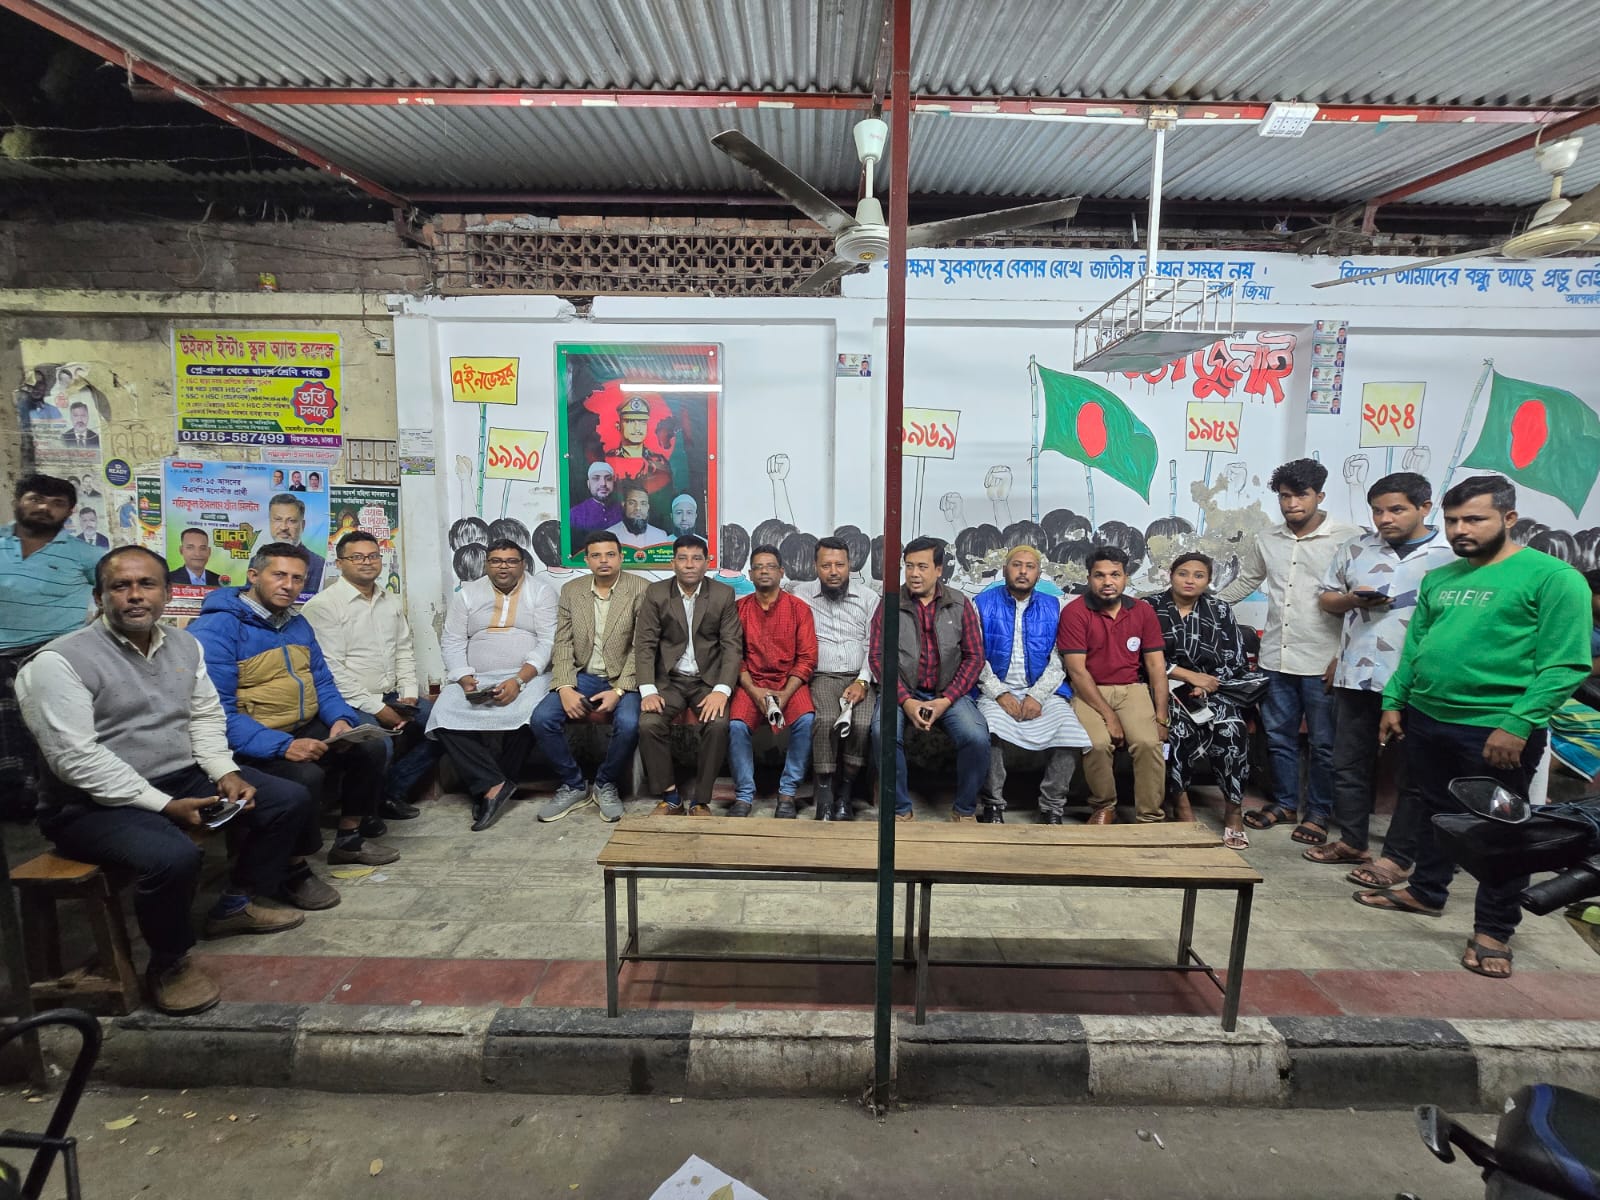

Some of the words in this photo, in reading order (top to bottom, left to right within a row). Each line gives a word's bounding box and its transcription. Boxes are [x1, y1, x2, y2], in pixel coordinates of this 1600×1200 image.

[938, 259, 1005, 285] যুবকদের
[1007, 259, 1048, 279] বেকার
[1050, 260, 1084, 279] রেখে
[1089, 255, 1136, 280] জাতীয়
[1228, 261, 1256, 280] নয়
[1394, 265, 1461, 288] আমাদের
[1464, 268, 1495, 293] বন্ধু
[1498, 268, 1537, 292] আছে
[1542, 268, 1573, 293] প্রভু
[1242, 281, 1276, 301] জিয়া
[247, 340, 267, 364] স্কুল
[300, 342, 335, 360] কলেজ
[226, 367, 250, 376] থেকে
[1192, 330, 1297, 403] জুলাই
[298, 388, 327, 405] ভর্তি
[299, 405, 330, 419] চলছে
[1363, 403, 1415, 437] ২০২৪
[182, 431, 285, 443] 01916-587499
[1188, 417, 1240, 450] ১৯৫২
[488, 445, 540, 471] ১৯৯০
